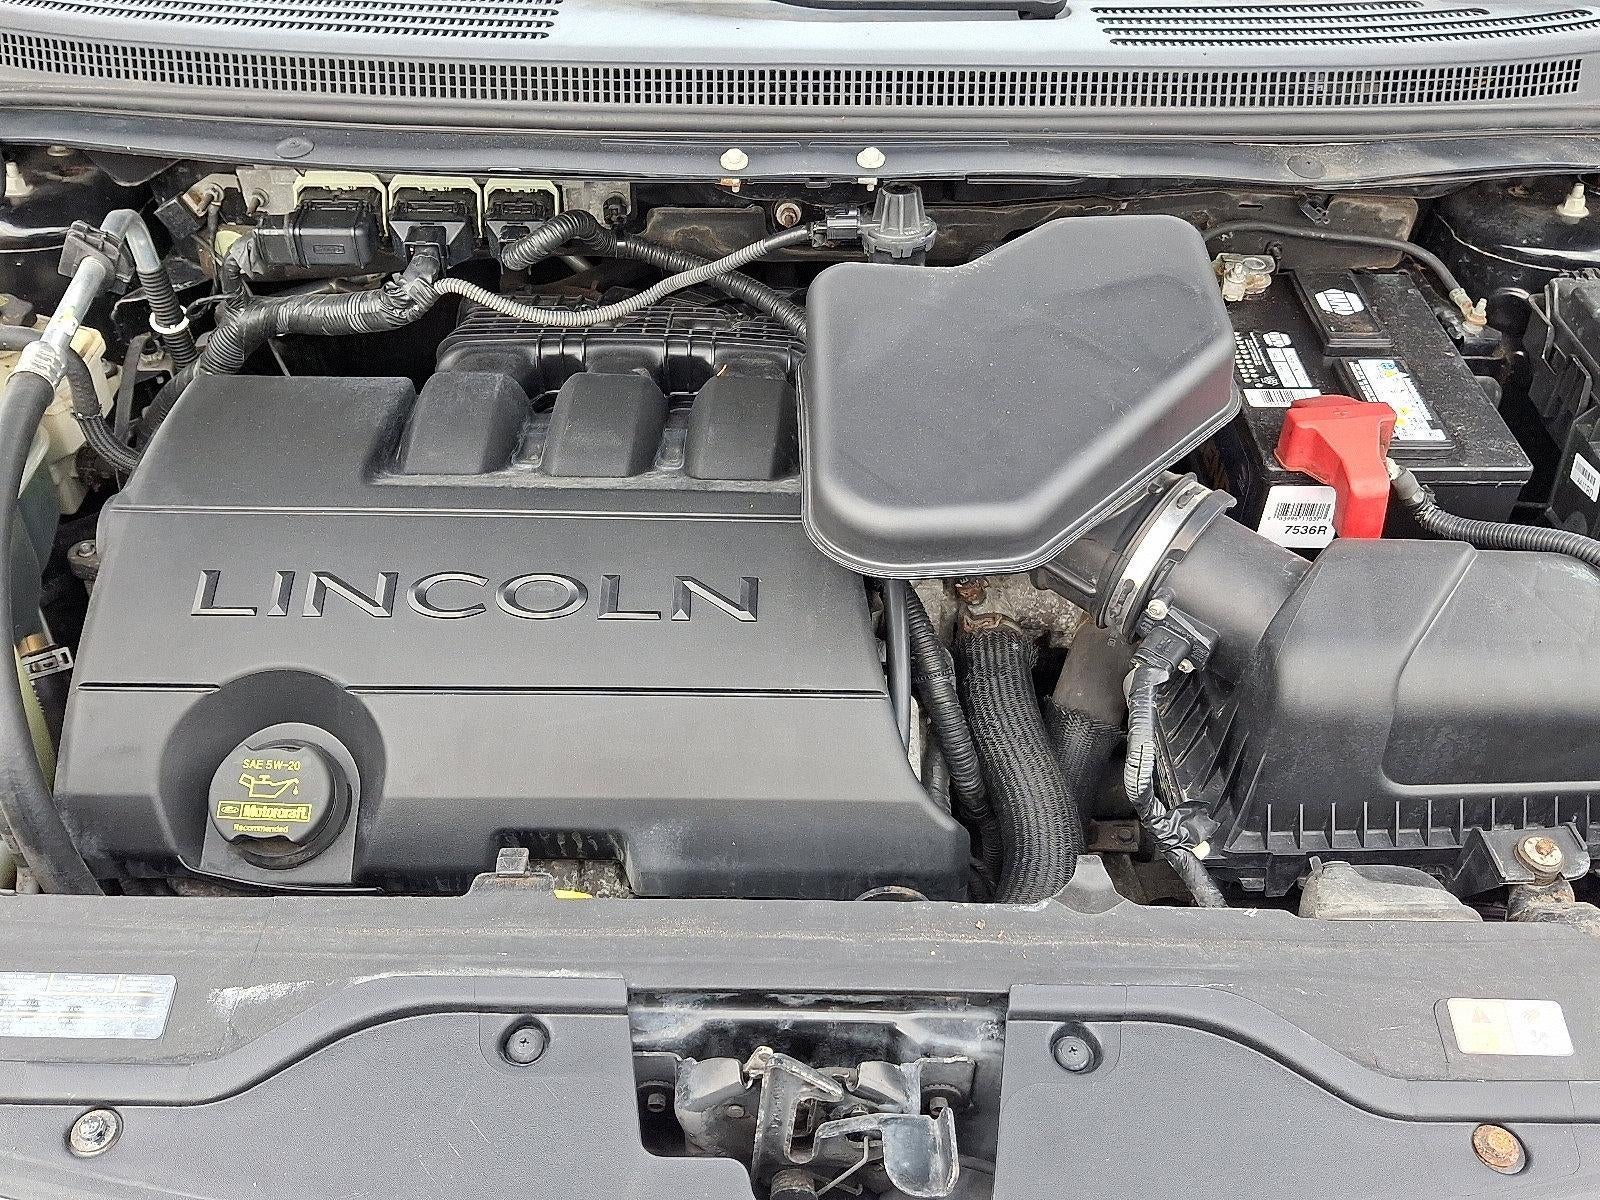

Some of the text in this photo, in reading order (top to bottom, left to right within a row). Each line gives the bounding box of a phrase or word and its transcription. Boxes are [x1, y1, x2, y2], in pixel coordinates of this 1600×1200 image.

[1284, 525, 1328, 535] 7536R
[191, 570, 759, 622] LINCOLN
[242, 758, 300, 771] SAE 5W-20
[243, 804, 308, 820] Motorcraft
[233, 823, 289, 833] Recommended
